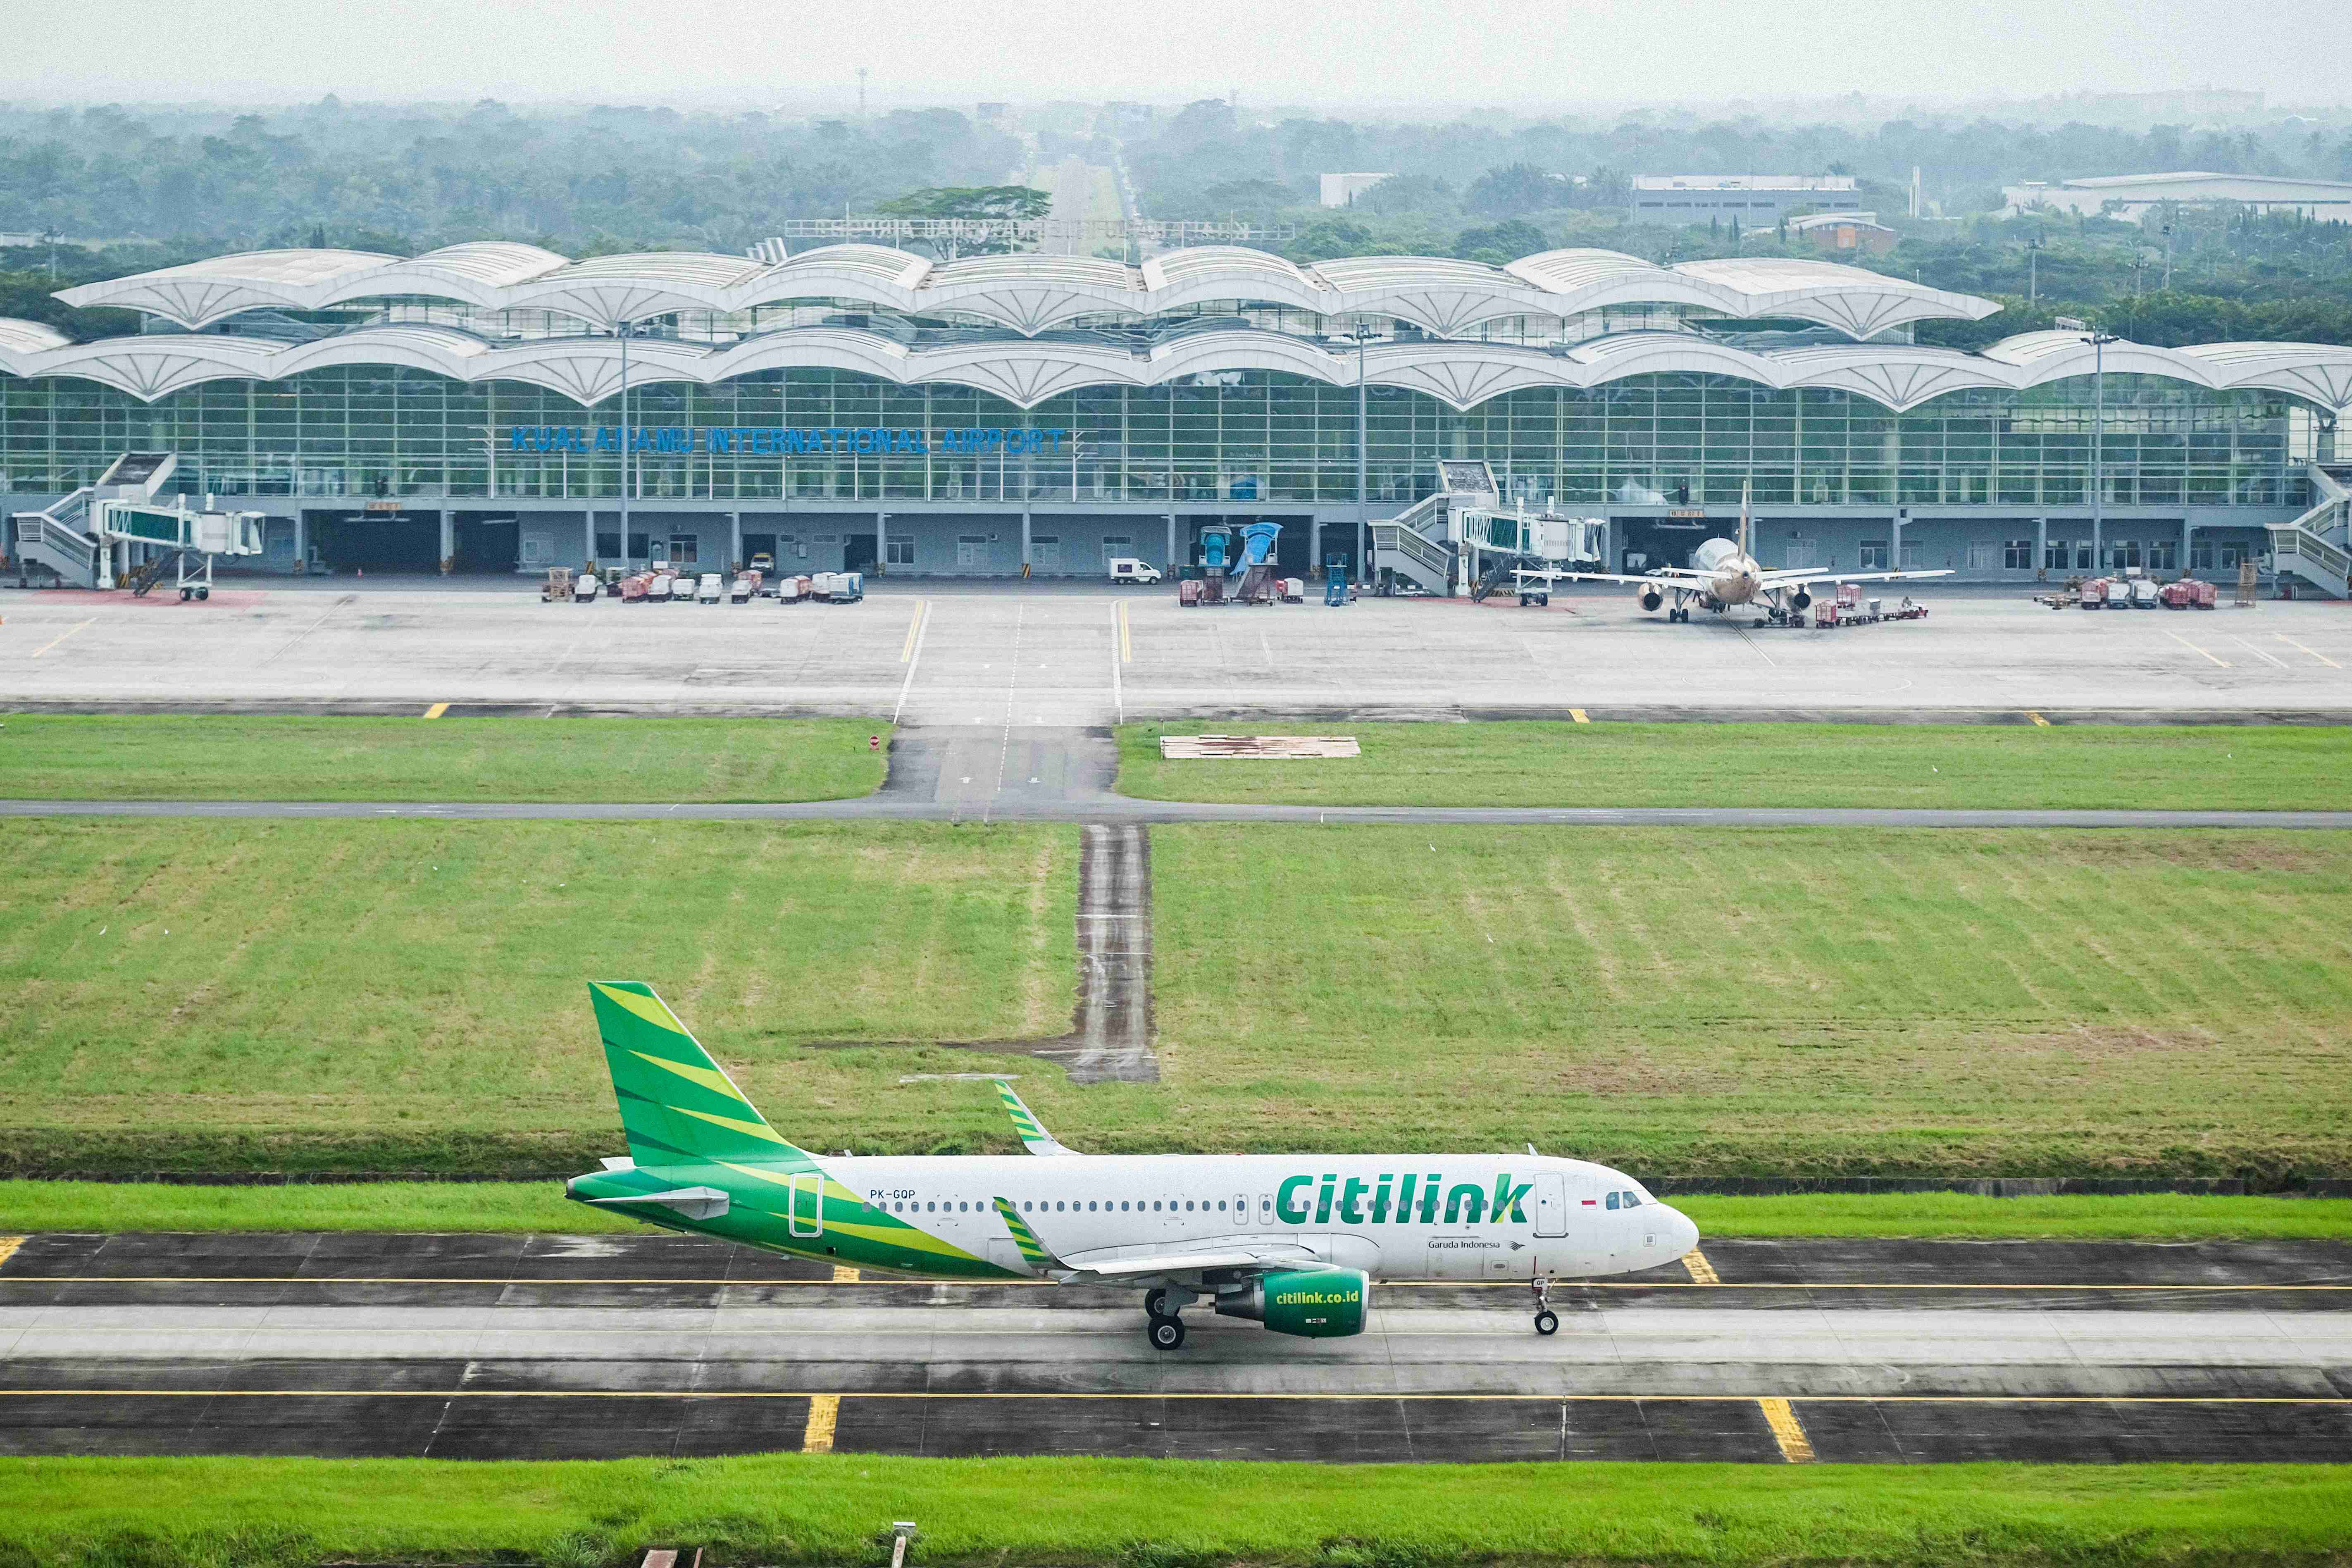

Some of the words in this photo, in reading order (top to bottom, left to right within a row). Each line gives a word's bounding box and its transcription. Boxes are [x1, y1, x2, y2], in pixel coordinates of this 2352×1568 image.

[705, 428, 928, 454] INTERNATIONAL
[942, 428, 1065, 454] AIRPORT
[870, 1190, 915, 1199] PK-GQP
[1276, 1173, 1534, 1225] Citilink
[1276, 1290, 1359, 1305] citilink.co.id
